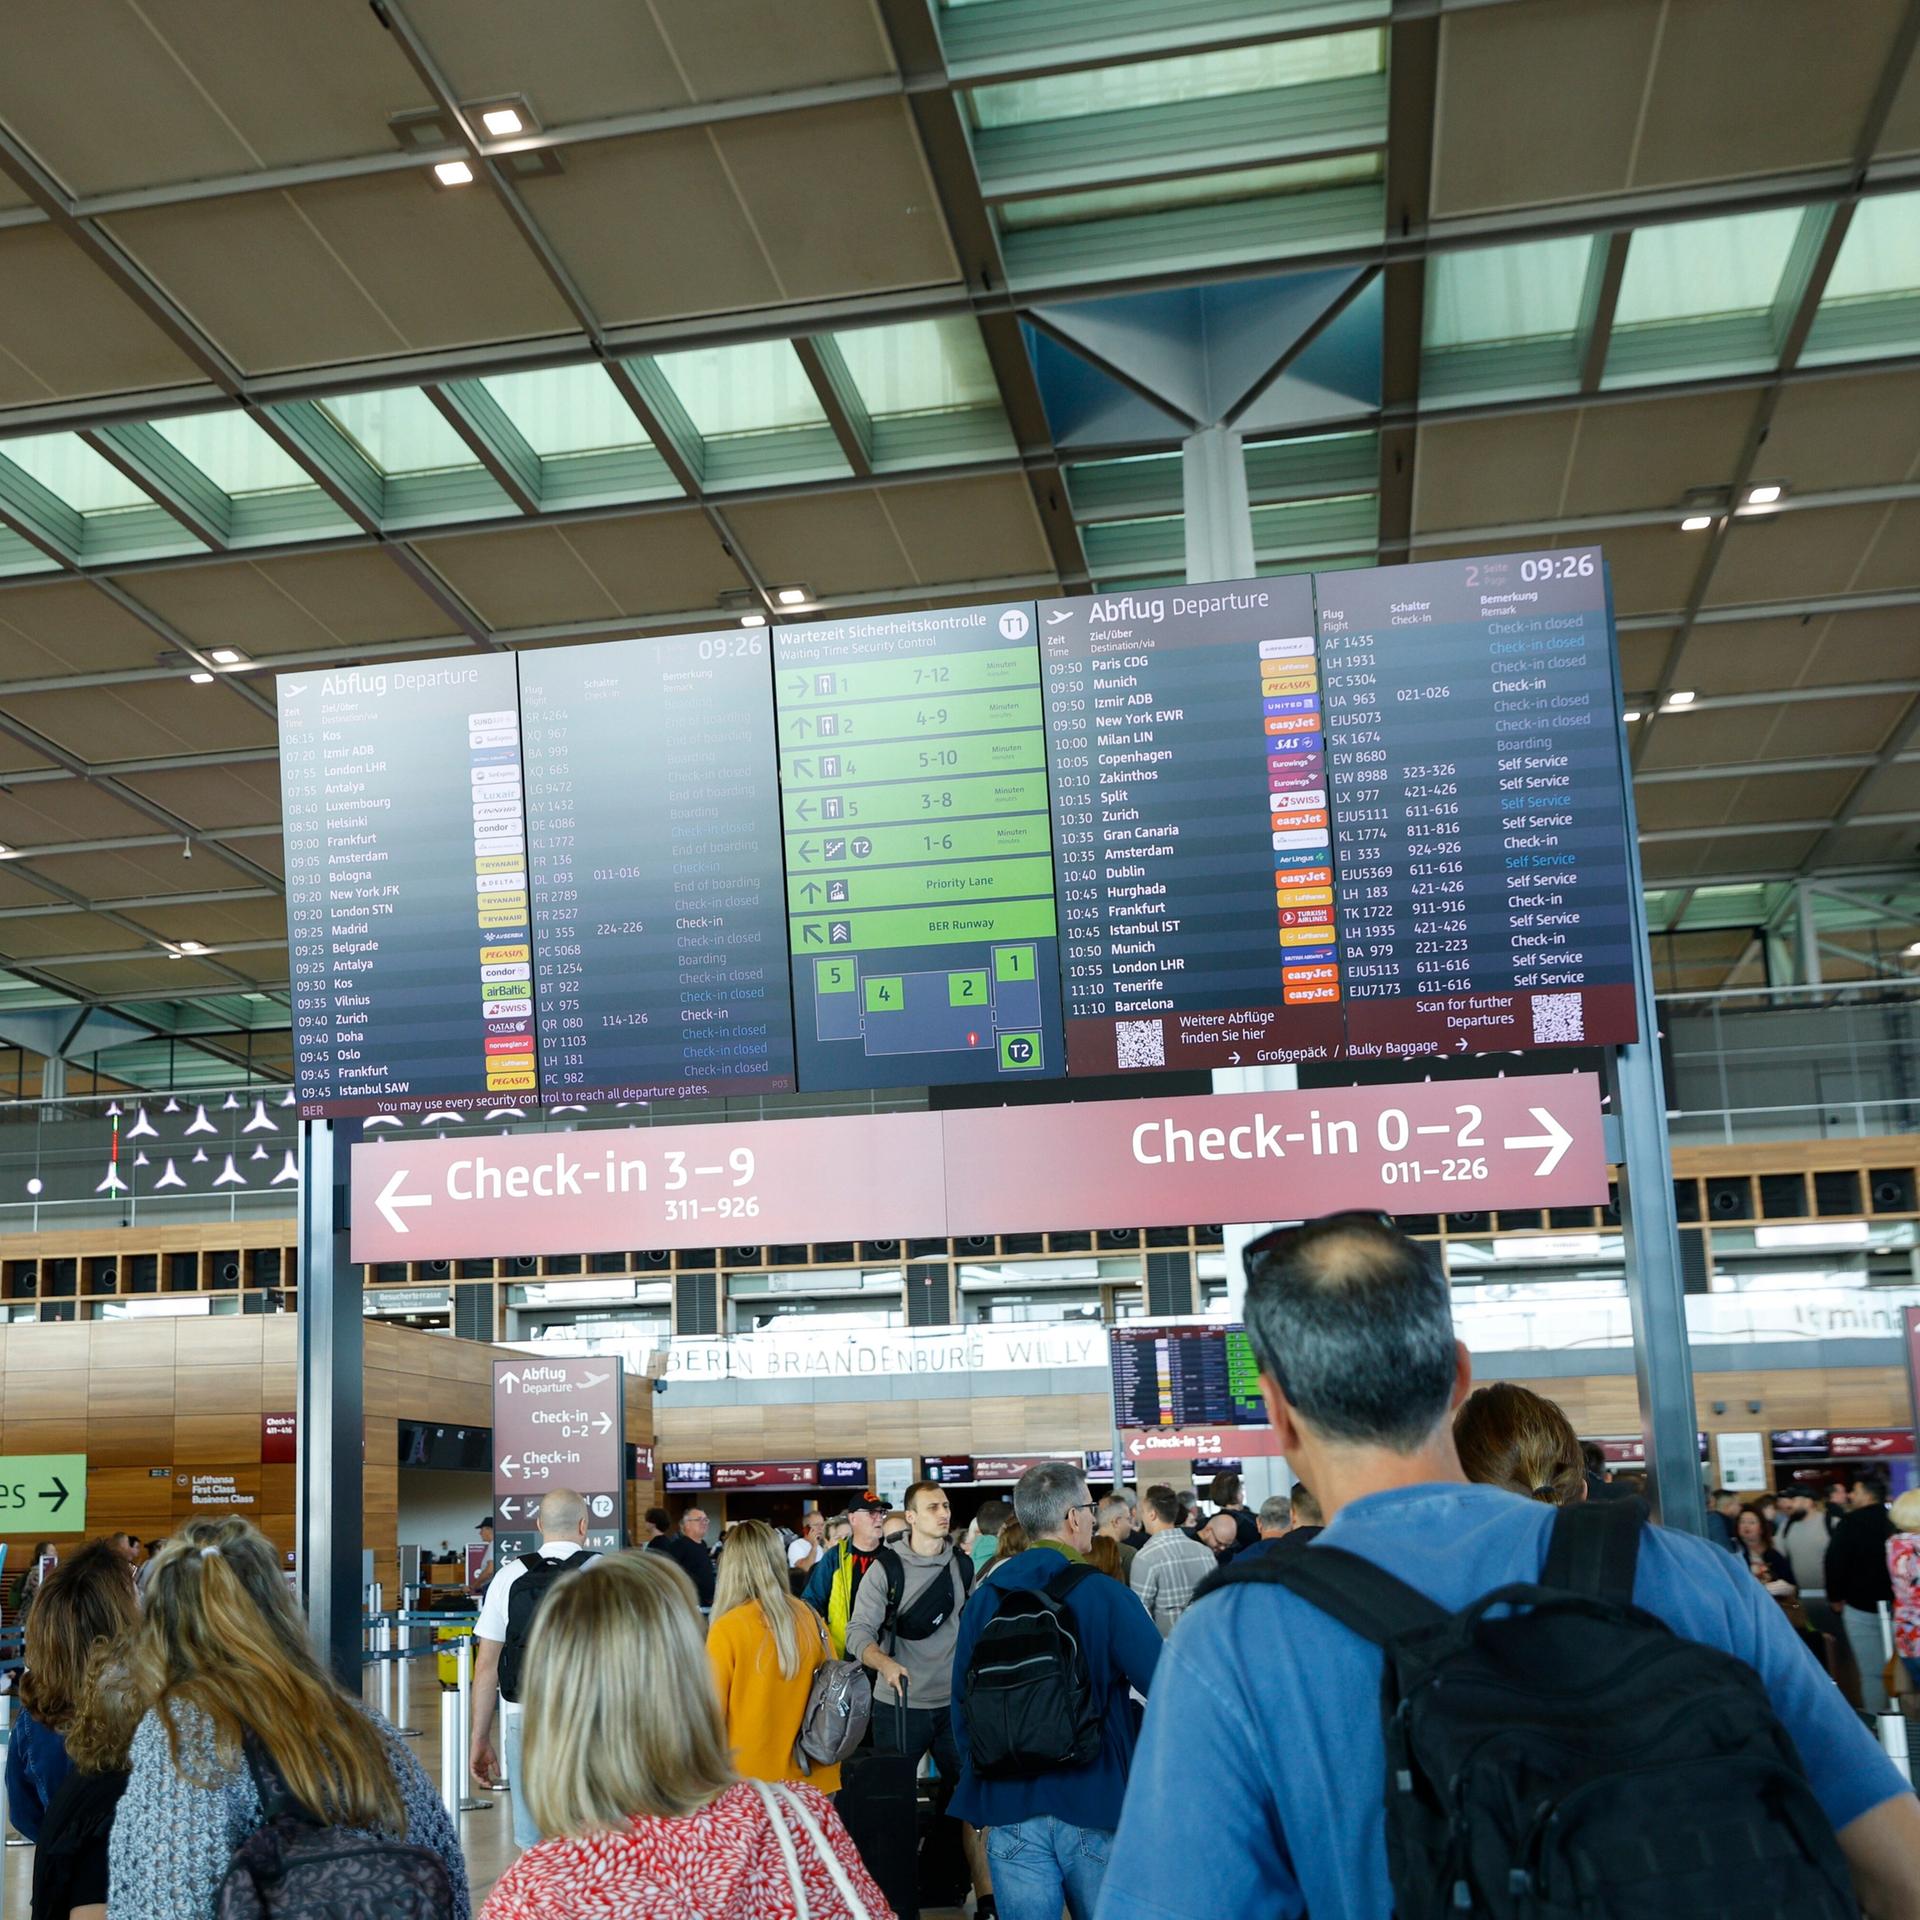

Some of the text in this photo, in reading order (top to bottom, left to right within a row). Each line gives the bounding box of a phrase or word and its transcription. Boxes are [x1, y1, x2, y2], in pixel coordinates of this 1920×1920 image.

[1520, 553, 1595, 582] 09:26
[1089, 593, 1268, 623] Abflug Departure
[1323, 592, 1538, 620] Flug Schalter Bemerkung
[1003, 617, 1024, 634] T1
[1324, 621, 1348, 633] Flight
[1482, 605, 1516, 616] Remark
[779, 614, 987, 645] Wartezeit Sicherheitskontrolle
[1048, 629, 1133, 645] Zeit Ziel/über
[699, 635, 763, 660] 09:26
[780, 634, 937, 660] Waiting Time Security Control
[1048, 639, 1155, 656] Time Destination/via
[1050, 656, 1148, 675] 09:50 Paris CDG
[322, 668, 479, 697] Abflug Departure
[841, 666, 950, 693] 1 7-12
[1493, 679, 1546, 693] Check-in
[1397, 686, 1449, 701] 021-026
[1268, 701, 1303, 710] UNITED
[844, 708, 948, 734] 2 4-9
[1096, 709, 1183, 727] New York EWR
[1270, 718, 1314, 731] easyJet
[1275, 738, 1299, 749] SAS
[846, 744, 1022, 775] 4 5-10 Minuten
[1273, 760, 1308, 769] Eurowings
[1498, 757, 1568, 771] Self Service
[1335, 769, 1387, 784] EW 8988
[1403, 764, 1455, 778] 323-326
[849, 786, 1025, 817] 5 3-8 Minuten
[1059, 790, 1128, 806] 10:15 Split
[853, 828, 1028, 854] T2 1-6 Minuten
[594, 867, 640, 880] 011-016
[1342, 866, 1392, 880] EJU5369
[926, 876, 994, 890] Priority Lane
[1107, 882, 1166, 899] Hurghada
[293, 892, 321, 903] 09:20
[357, 889, 379, 897] York
[383, 886, 399, 896] JFK
[1297, 910, 1327, 918] TURKISH
[1412, 900, 1465, 915] 911-916
[598, 922, 642, 934] 224-226
[676, 916, 723, 929] Check-in
[929, 918, 995, 931] BER Runway
[1110, 920, 1180, 936] Istanbul IST
[1297, 916, 1327, 924] AIRLINES
[538, 927, 574, 939] JU 355
[295, 940, 378, 956] 09:25 Belgrade
[1010, 955, 1019, 972] 1
[831, 967, 841, 984] 5
[487, 985, 526, 997] airBaltic
[878, 986, 890, 1002] 4
[962, 980, 973, 997] 2
[1289, 988, 1334, 1000] easyJet
[1073, 998, 1173, 1015] 11:10 Barcelona
[1416, 996, 1513, 1013] Scan for further
[603, 1013, 647, 1026] 114-126
[1179, 1011, 1275, 1027] Weitere Abflüge
[1447, 1014, 1514, 1029] Departures
[488, 1023, 516, 1032] QATAR
[300, 1030, 363, 1046] 09:40 Doha
[1181, 1028, 1265, 1044] finden Sie hier
[1010, 1044, 1029, 1058] T2
[1257, 1041, 1438, 1063] Großgepäck Bulky Baggage
[492, 1076, 530, 1086] PEGASUS
[302, 1082, 409, 1099] 09:45 Istanbul SAW
[377, 1101, 397, 1113] You
[400, 1101, 422, 1113] may
[424, 1100, 442, 1110] use
[444, 1098, 473, 1111] every
[476, 1093, 516, 1108] security
[561, 1090, 573, 1102] to
[576, 1087, 606, 1101] reach
[607, 1086, 620, 1099] all
[623, 1085, 675, 1100] departure
[678, 1084, 710, 1097] gates.
[302, 1105, 324, 1117] BER
[1132, 1110, 1357, 1164] Check-in
[446, 1150, 647, 1200] Check-in
[522, 1367, 566, 1381] Abflug
[522, 1383, 573, 1395] Departure
[266, 1417, 295, 1426] Check-in
[531, 1409, 588, 1424] Check-in
[1146, 1435, 1195, 1448] Check-in
[522, 1451, 580, 1464] Check-in
[836, 1461, 862, 1477] Priority Lane
[192, 1475, 234, 1484] Lufthansa
[192, 1485, 236, 1494] First Class
[192, 1494, 254, 1504] Business Class
[595, 1501, 610, 1513] T2
